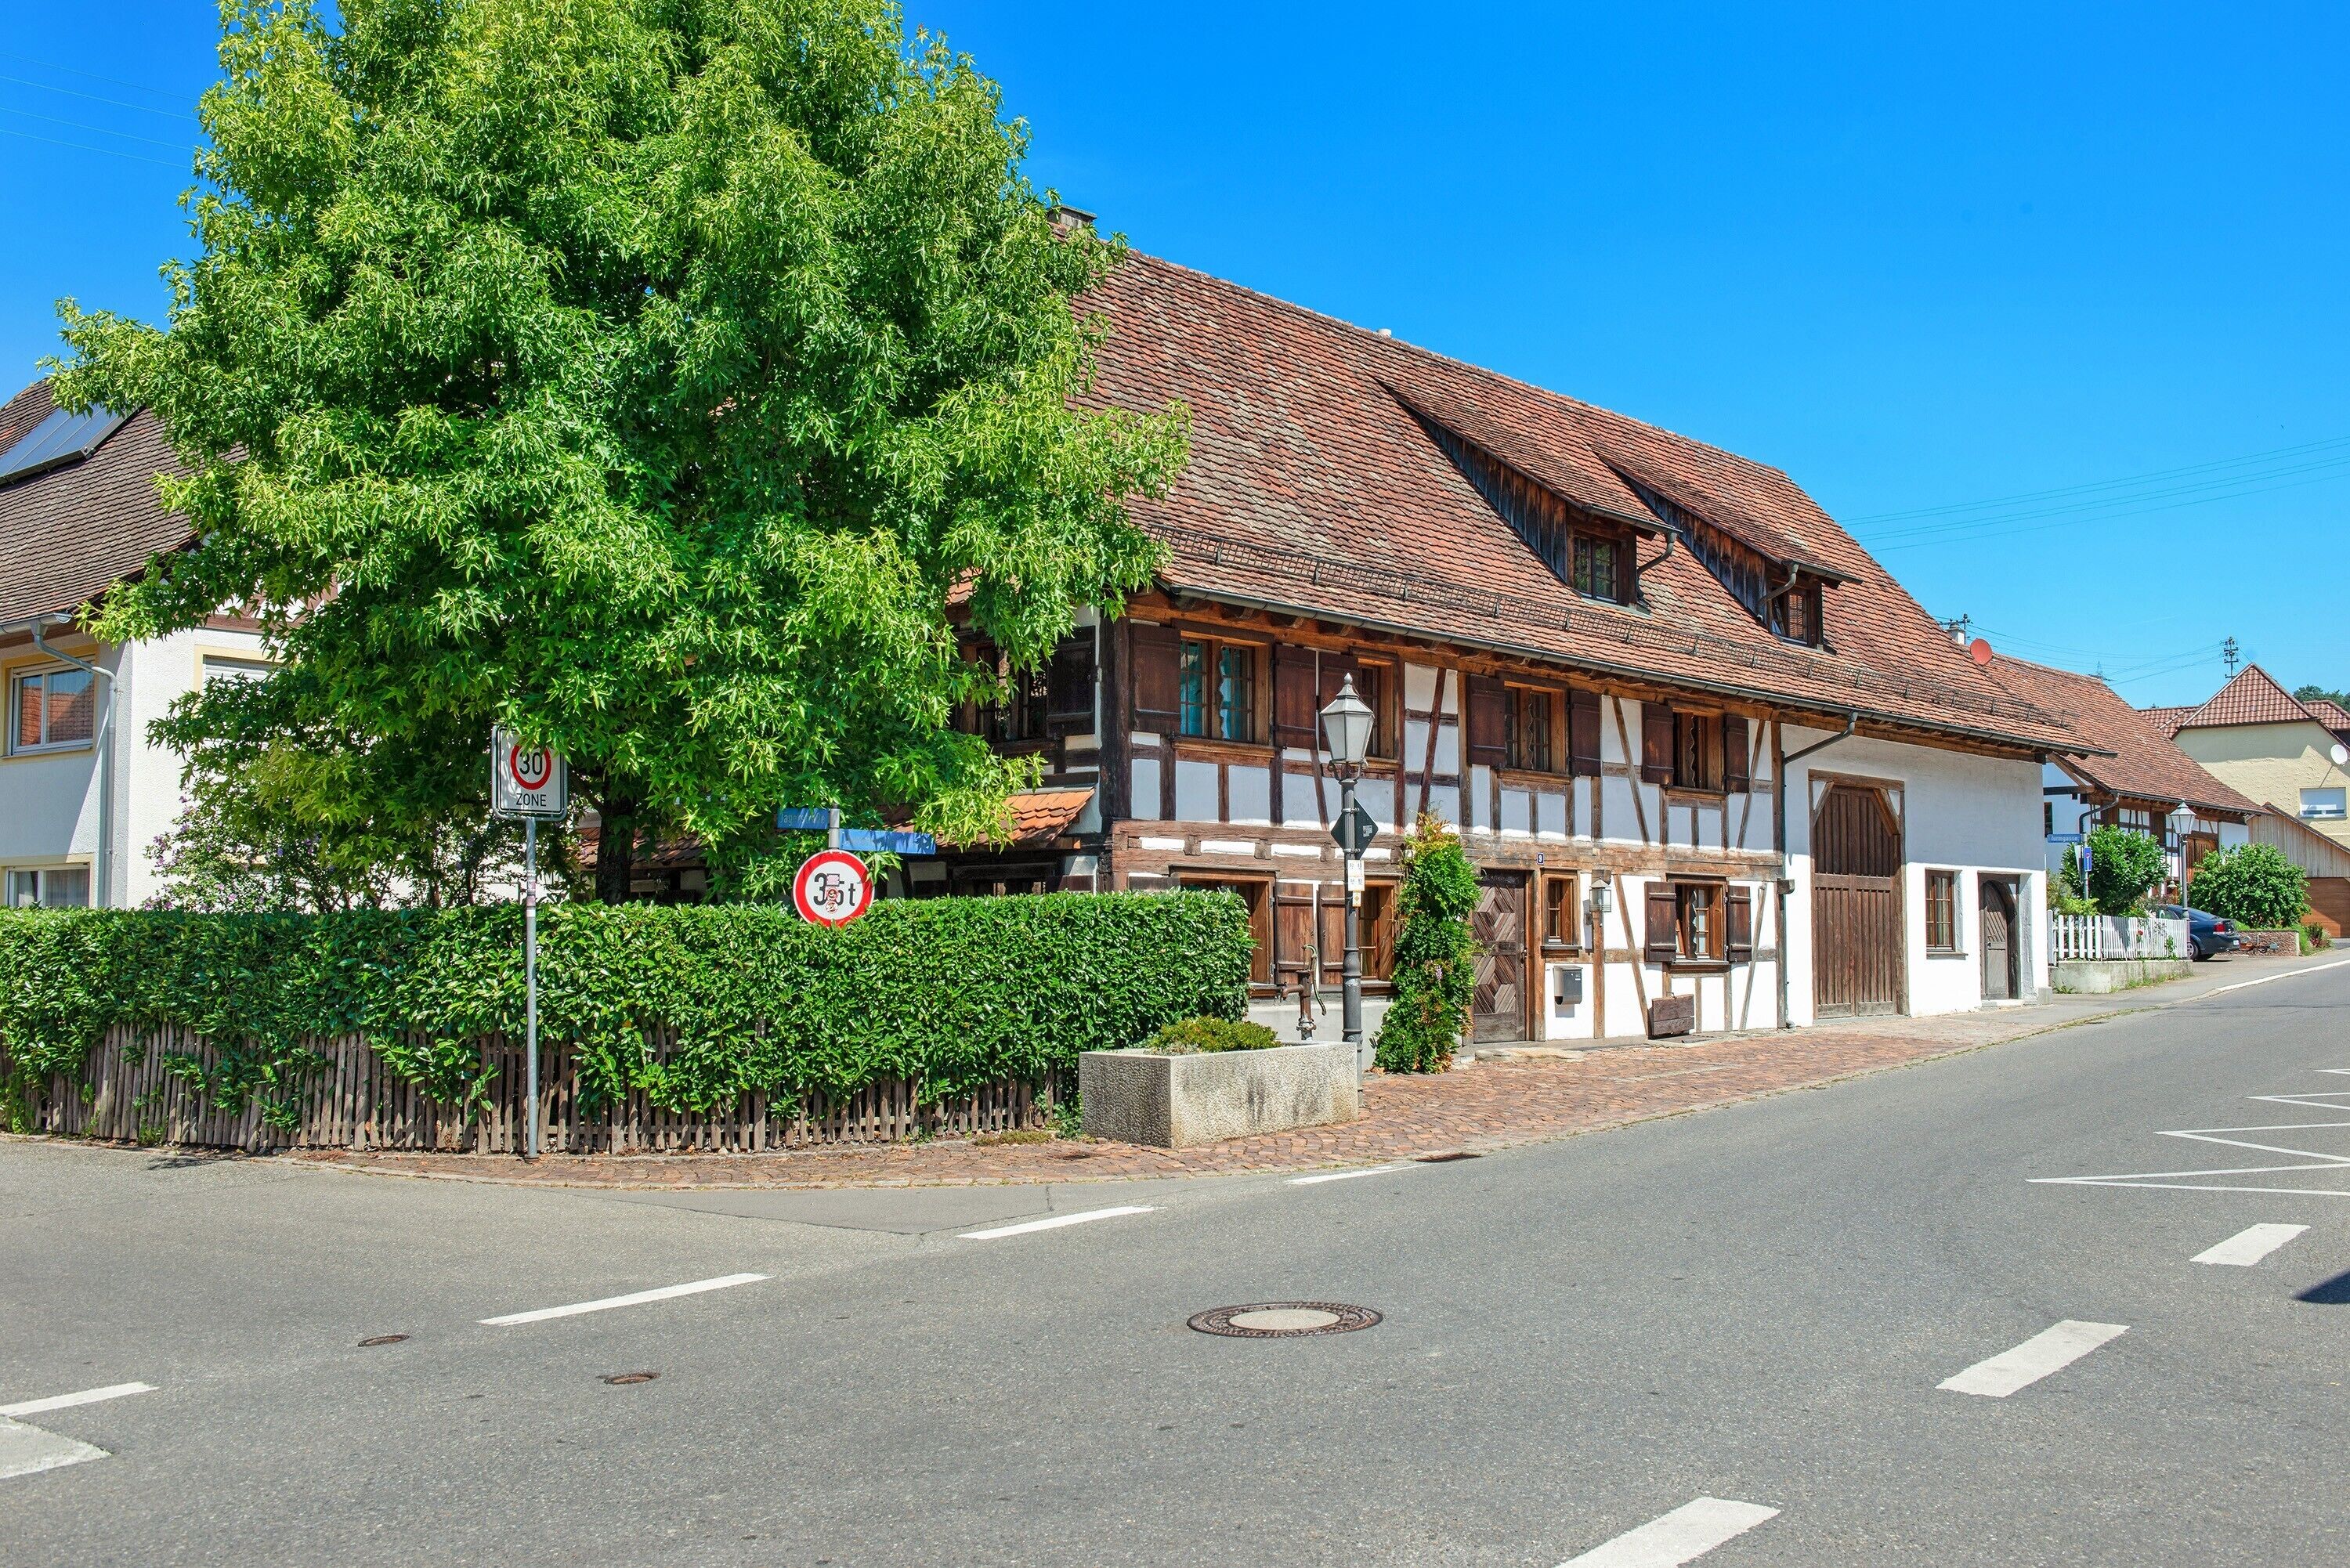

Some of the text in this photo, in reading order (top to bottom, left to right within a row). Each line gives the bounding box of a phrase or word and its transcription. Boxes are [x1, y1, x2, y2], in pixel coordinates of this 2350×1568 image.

[519, 752, 543, 775] 30
[515, 793, 547, 807] ZONE
[1538, 854, 1542, 863] 9
[848, 883, 856, 907] t
